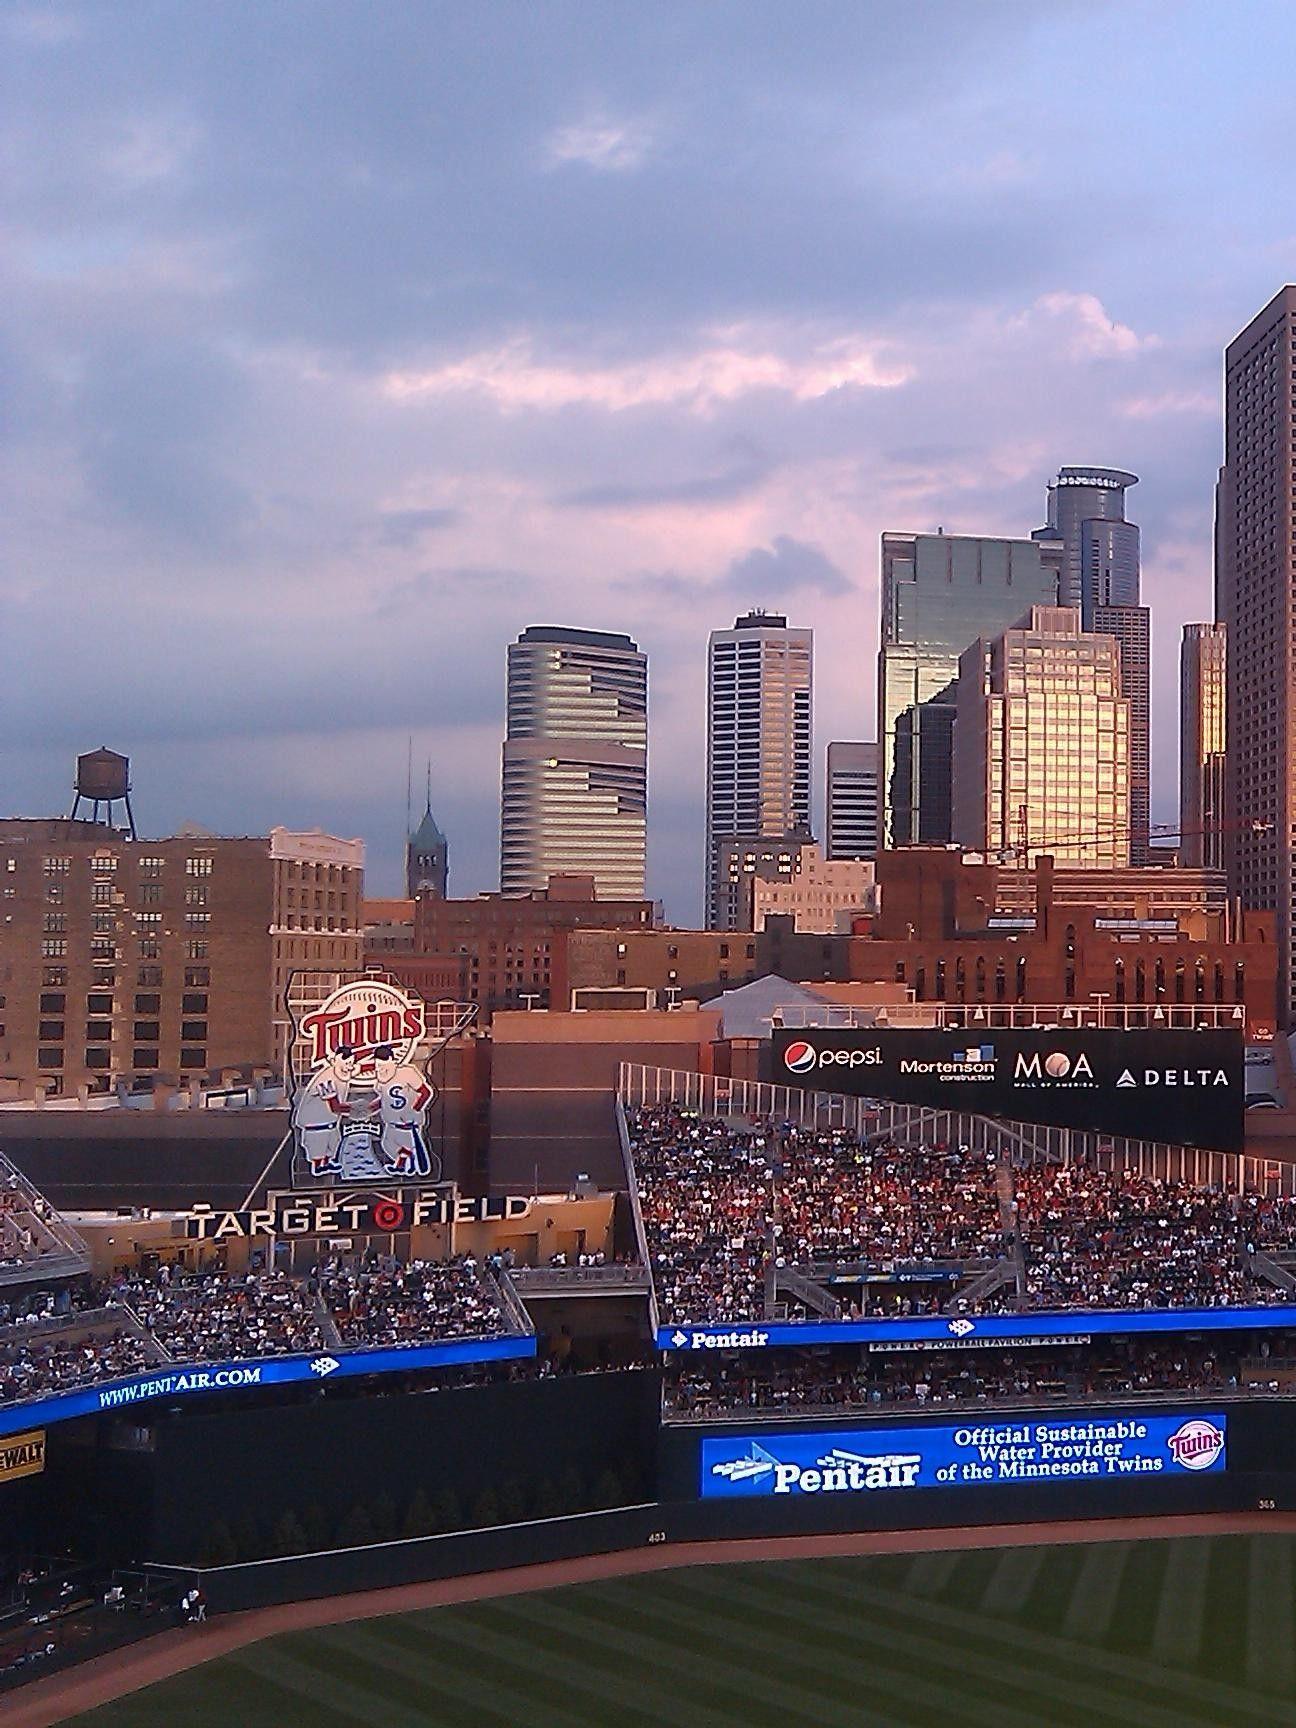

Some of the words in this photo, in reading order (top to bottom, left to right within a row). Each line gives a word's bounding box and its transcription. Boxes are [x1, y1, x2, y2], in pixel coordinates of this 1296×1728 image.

[302, 1003, 424, 1063] Twins
[818, 1047, 881, 1069] pepsi
[900, 1060, 995, 1073] Mortenson
[939, 1074, 995, 1082] construction
[1144, 1069, 1229, 1086] DELTA
[188, 1205, 369, 1239] TARGET
[413, 1196, 533, 1226] FIELD
[691, 1330, 769, 1349] Pentair
[99, 1368, 261, 1408] WWW.PENTAIR.COM
[954, 1425, 1030, 1447] Official
[1035, 1421, 1147, 1443] Sustainable
[1168, 1431, 1222, 1459] Twins
[978, 1444, 1036, 1463] Water
[1040, 1441, 1123, 1460] Provider
[773, 1460, 920, 1494] Pentair
[936, 1464, 958, 1482] of
[962, 1461, 993, 1480] the
[998, 1457, 1100, 1479] Minnesota
[1105, 1453, 1164, 1474] Twins
